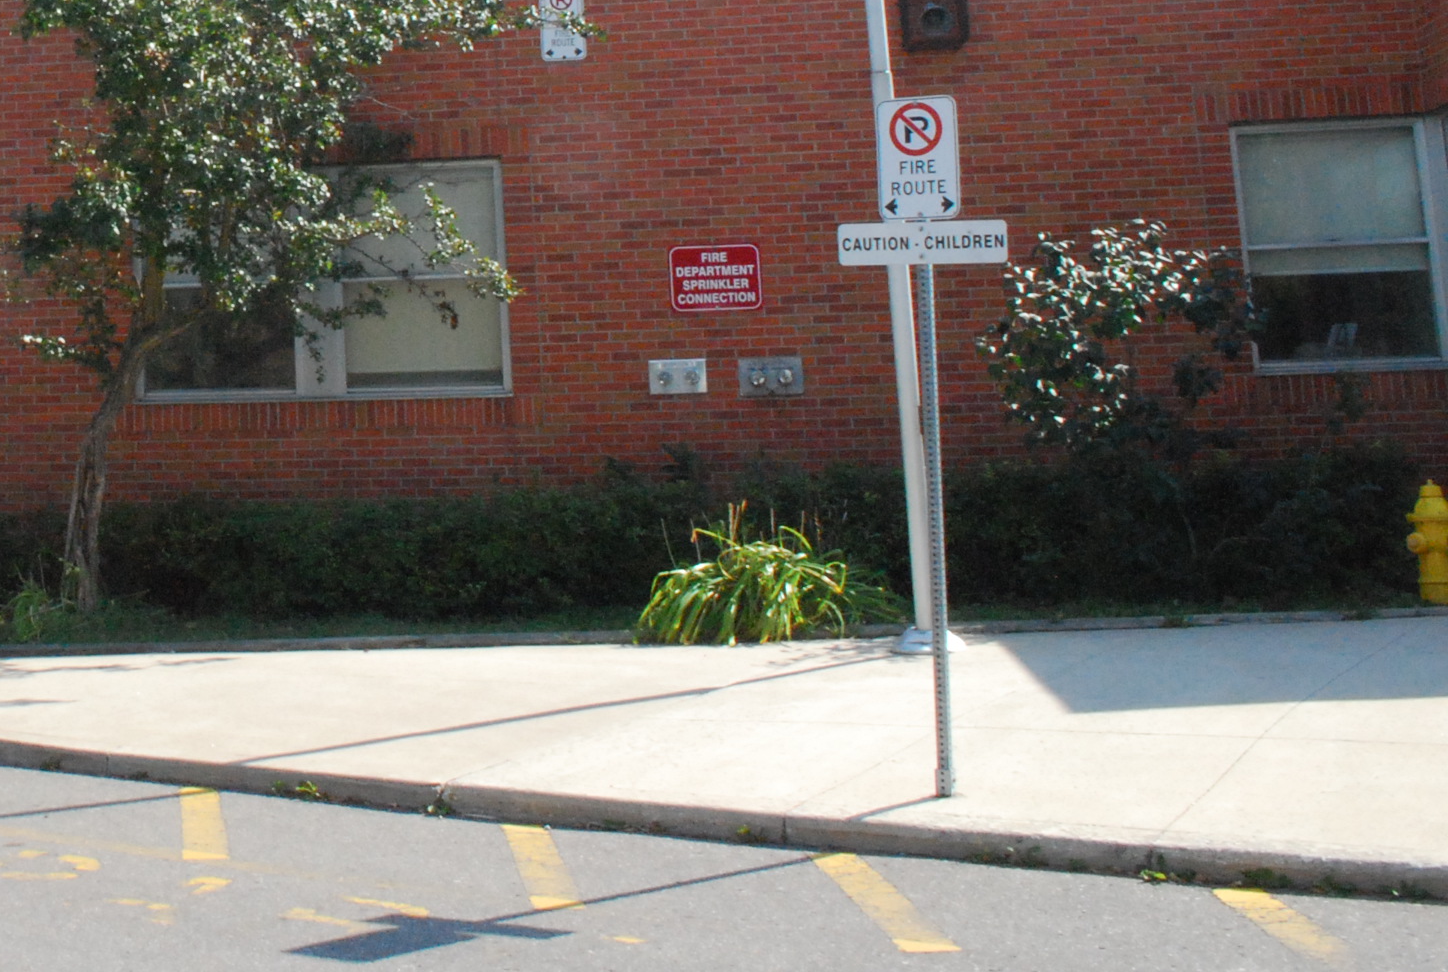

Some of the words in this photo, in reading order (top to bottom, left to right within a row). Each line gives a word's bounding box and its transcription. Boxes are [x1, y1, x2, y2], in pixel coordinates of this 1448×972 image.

[899, 159, 936, 175] FIRE
[891, 180, 946, 196] ROUTE
[842, 236, 909, 251] CAUTION
[924, 234, 1004, 250] CHILDREN
[701, 251, 727, 263] FIRE
[676, 264, 754, 277] DEPARTMENT
[682, 278, 749, 291] SPRINKLER
[678, 292, 755, 304] CONNECTION
